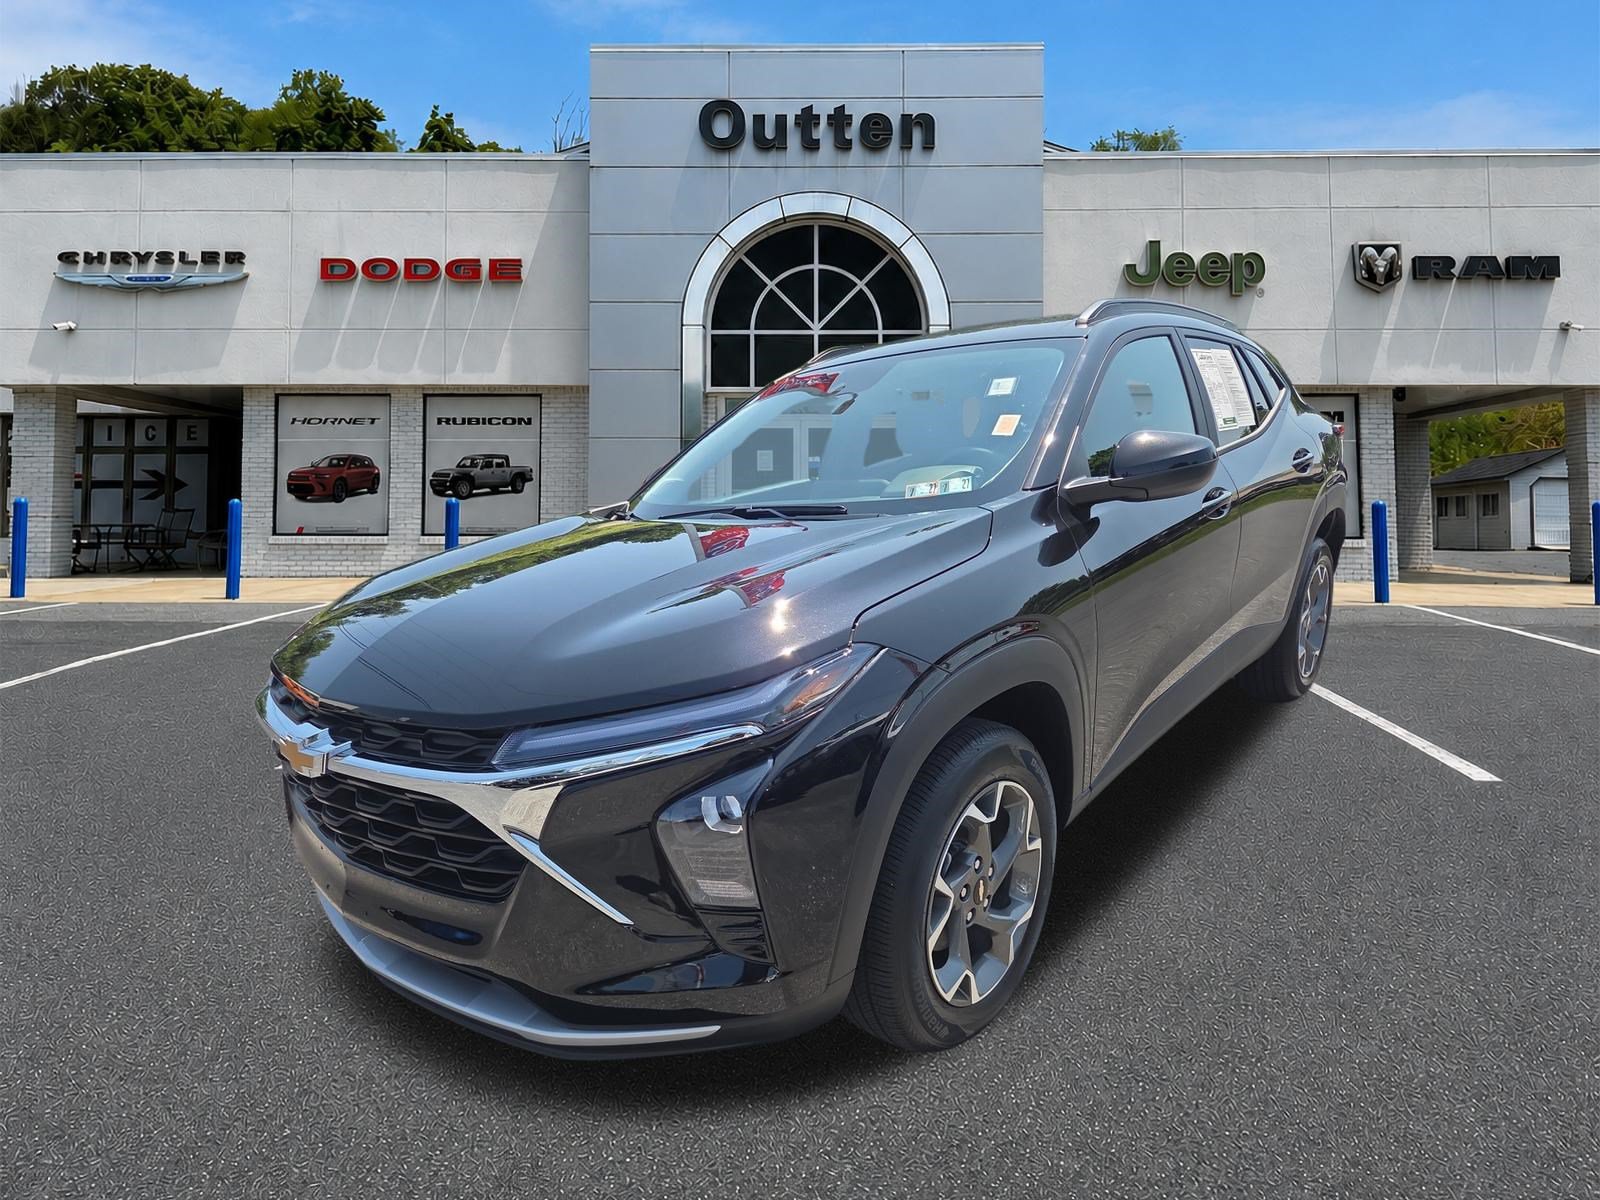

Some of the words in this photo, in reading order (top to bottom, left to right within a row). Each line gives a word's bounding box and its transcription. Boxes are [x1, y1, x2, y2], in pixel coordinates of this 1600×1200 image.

[699, 99, 936, 150] Outten
[57, 251, 247, 265] CHRYSLER
[320, 257, 523, 282] DODGE
[1123, 240, 1266, 296] Jeep
[1411, 255, 1561, 280] RAM
[290, 417, 381, 426] HORNET
[436, 416, 533, 426] RUBICON
